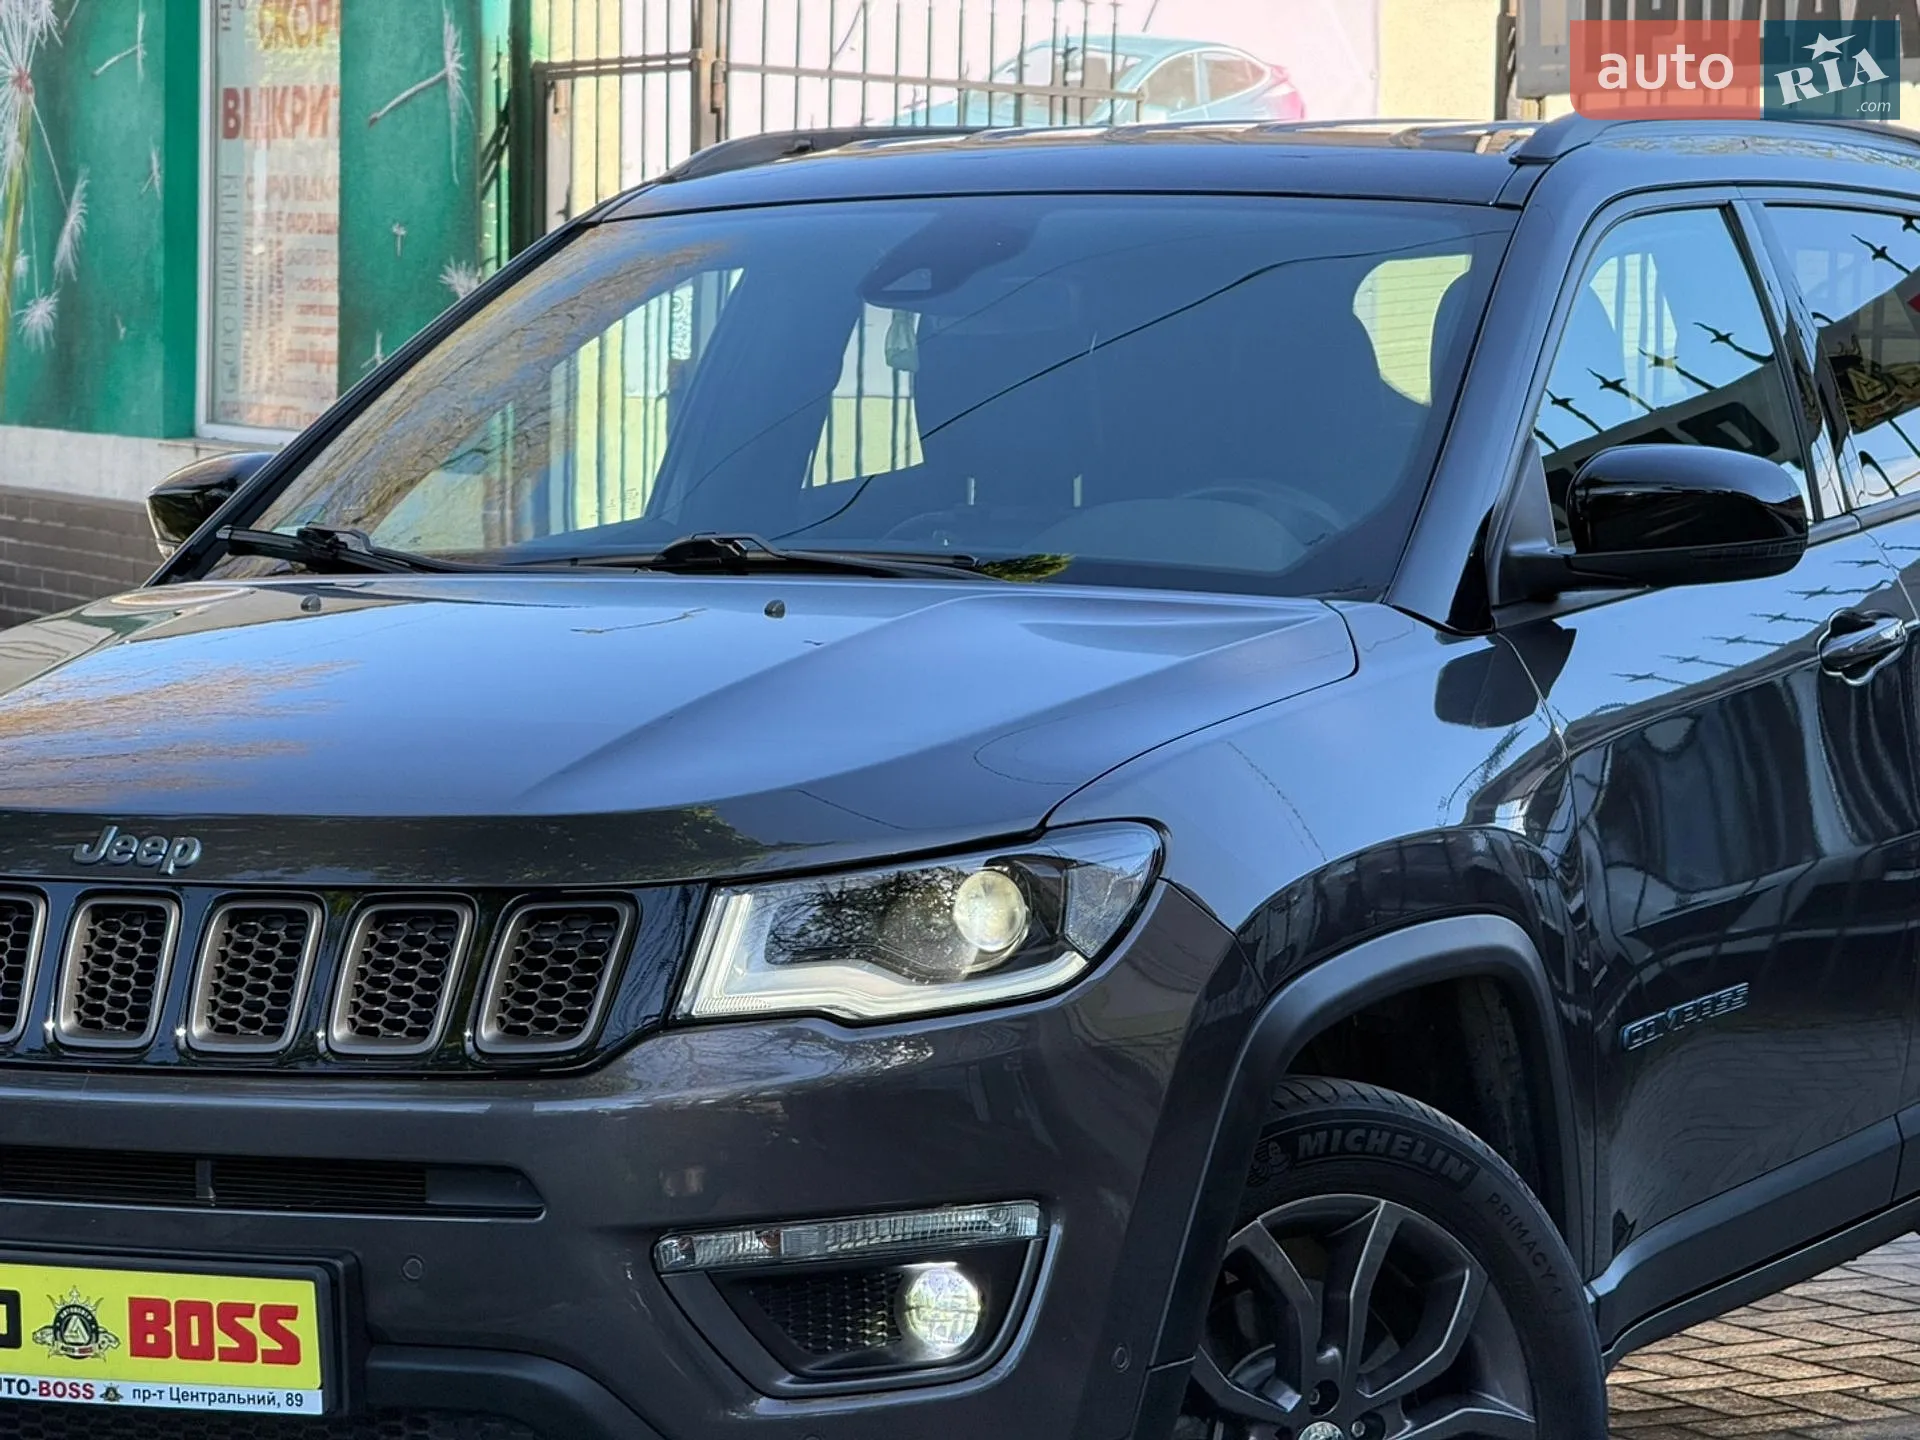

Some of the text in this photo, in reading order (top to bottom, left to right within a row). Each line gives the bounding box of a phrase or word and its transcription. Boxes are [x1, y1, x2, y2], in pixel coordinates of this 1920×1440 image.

[258, 0, 339, 49] СКОР
[73, 825, 202, 875] Jeep
[1298, 1128, 1472, 1181] MICHELIN
[1486, 1192, 1556, 1281] PRIMACY
[128, 1296, 302, 1366] BOSS
[0, 1377, 95, 1400] TO-BOSS
[132, 1387, 304, 1409] пр-т Центральний, 89
